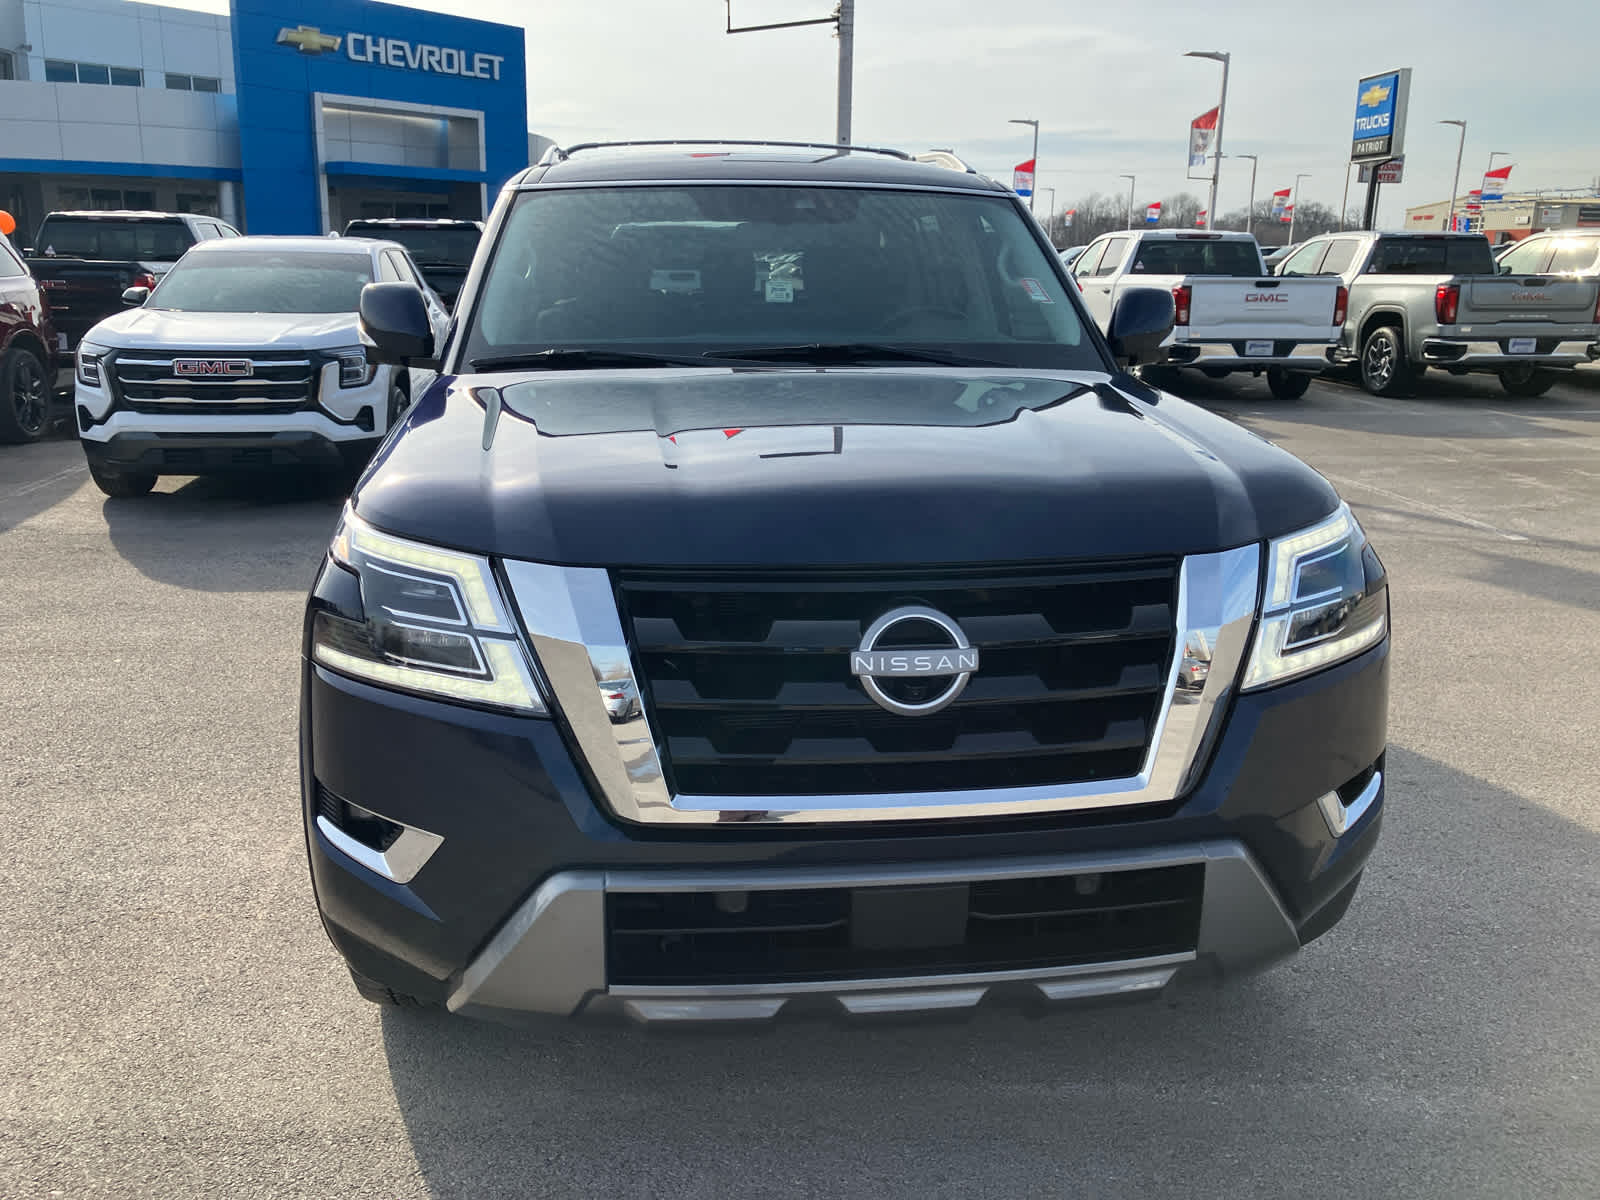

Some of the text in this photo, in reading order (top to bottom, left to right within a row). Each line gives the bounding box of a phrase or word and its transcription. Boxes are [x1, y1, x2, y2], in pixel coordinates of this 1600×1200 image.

[347, 32, 504, 80] CHEVROLET
[1356, 112, 1390, 131] TRUCKS
[1357, 141, 1383, 153] PATRIOT
[1245, 293, 1288, 303] GMC
[177, 361, 246, 374] GMC
[855, 654, 975, 671] NISSAN
